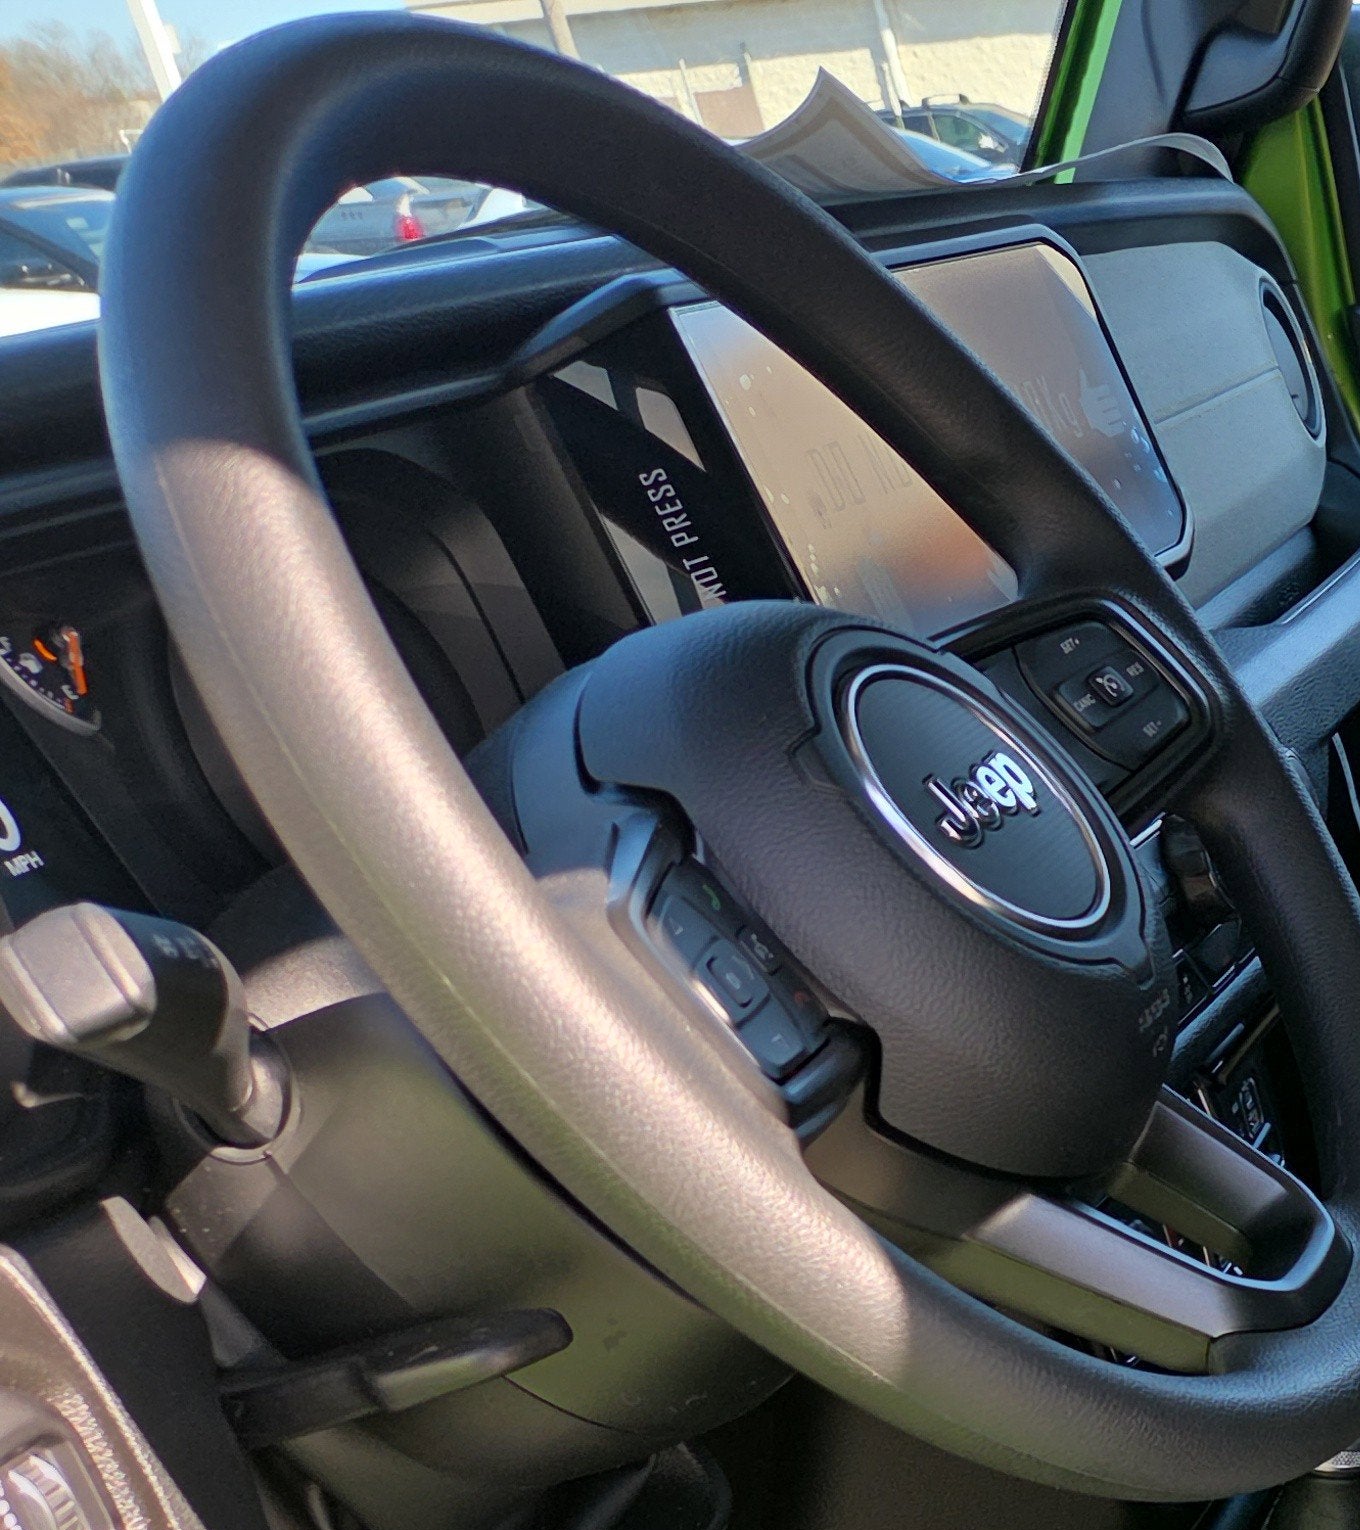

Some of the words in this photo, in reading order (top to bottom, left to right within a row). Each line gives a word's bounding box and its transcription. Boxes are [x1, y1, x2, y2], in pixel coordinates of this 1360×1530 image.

[638, 468, 700, 548] PRESS
[922, 749, 1041, 849] Jeep
[4, 851, 45, 877] MPH
